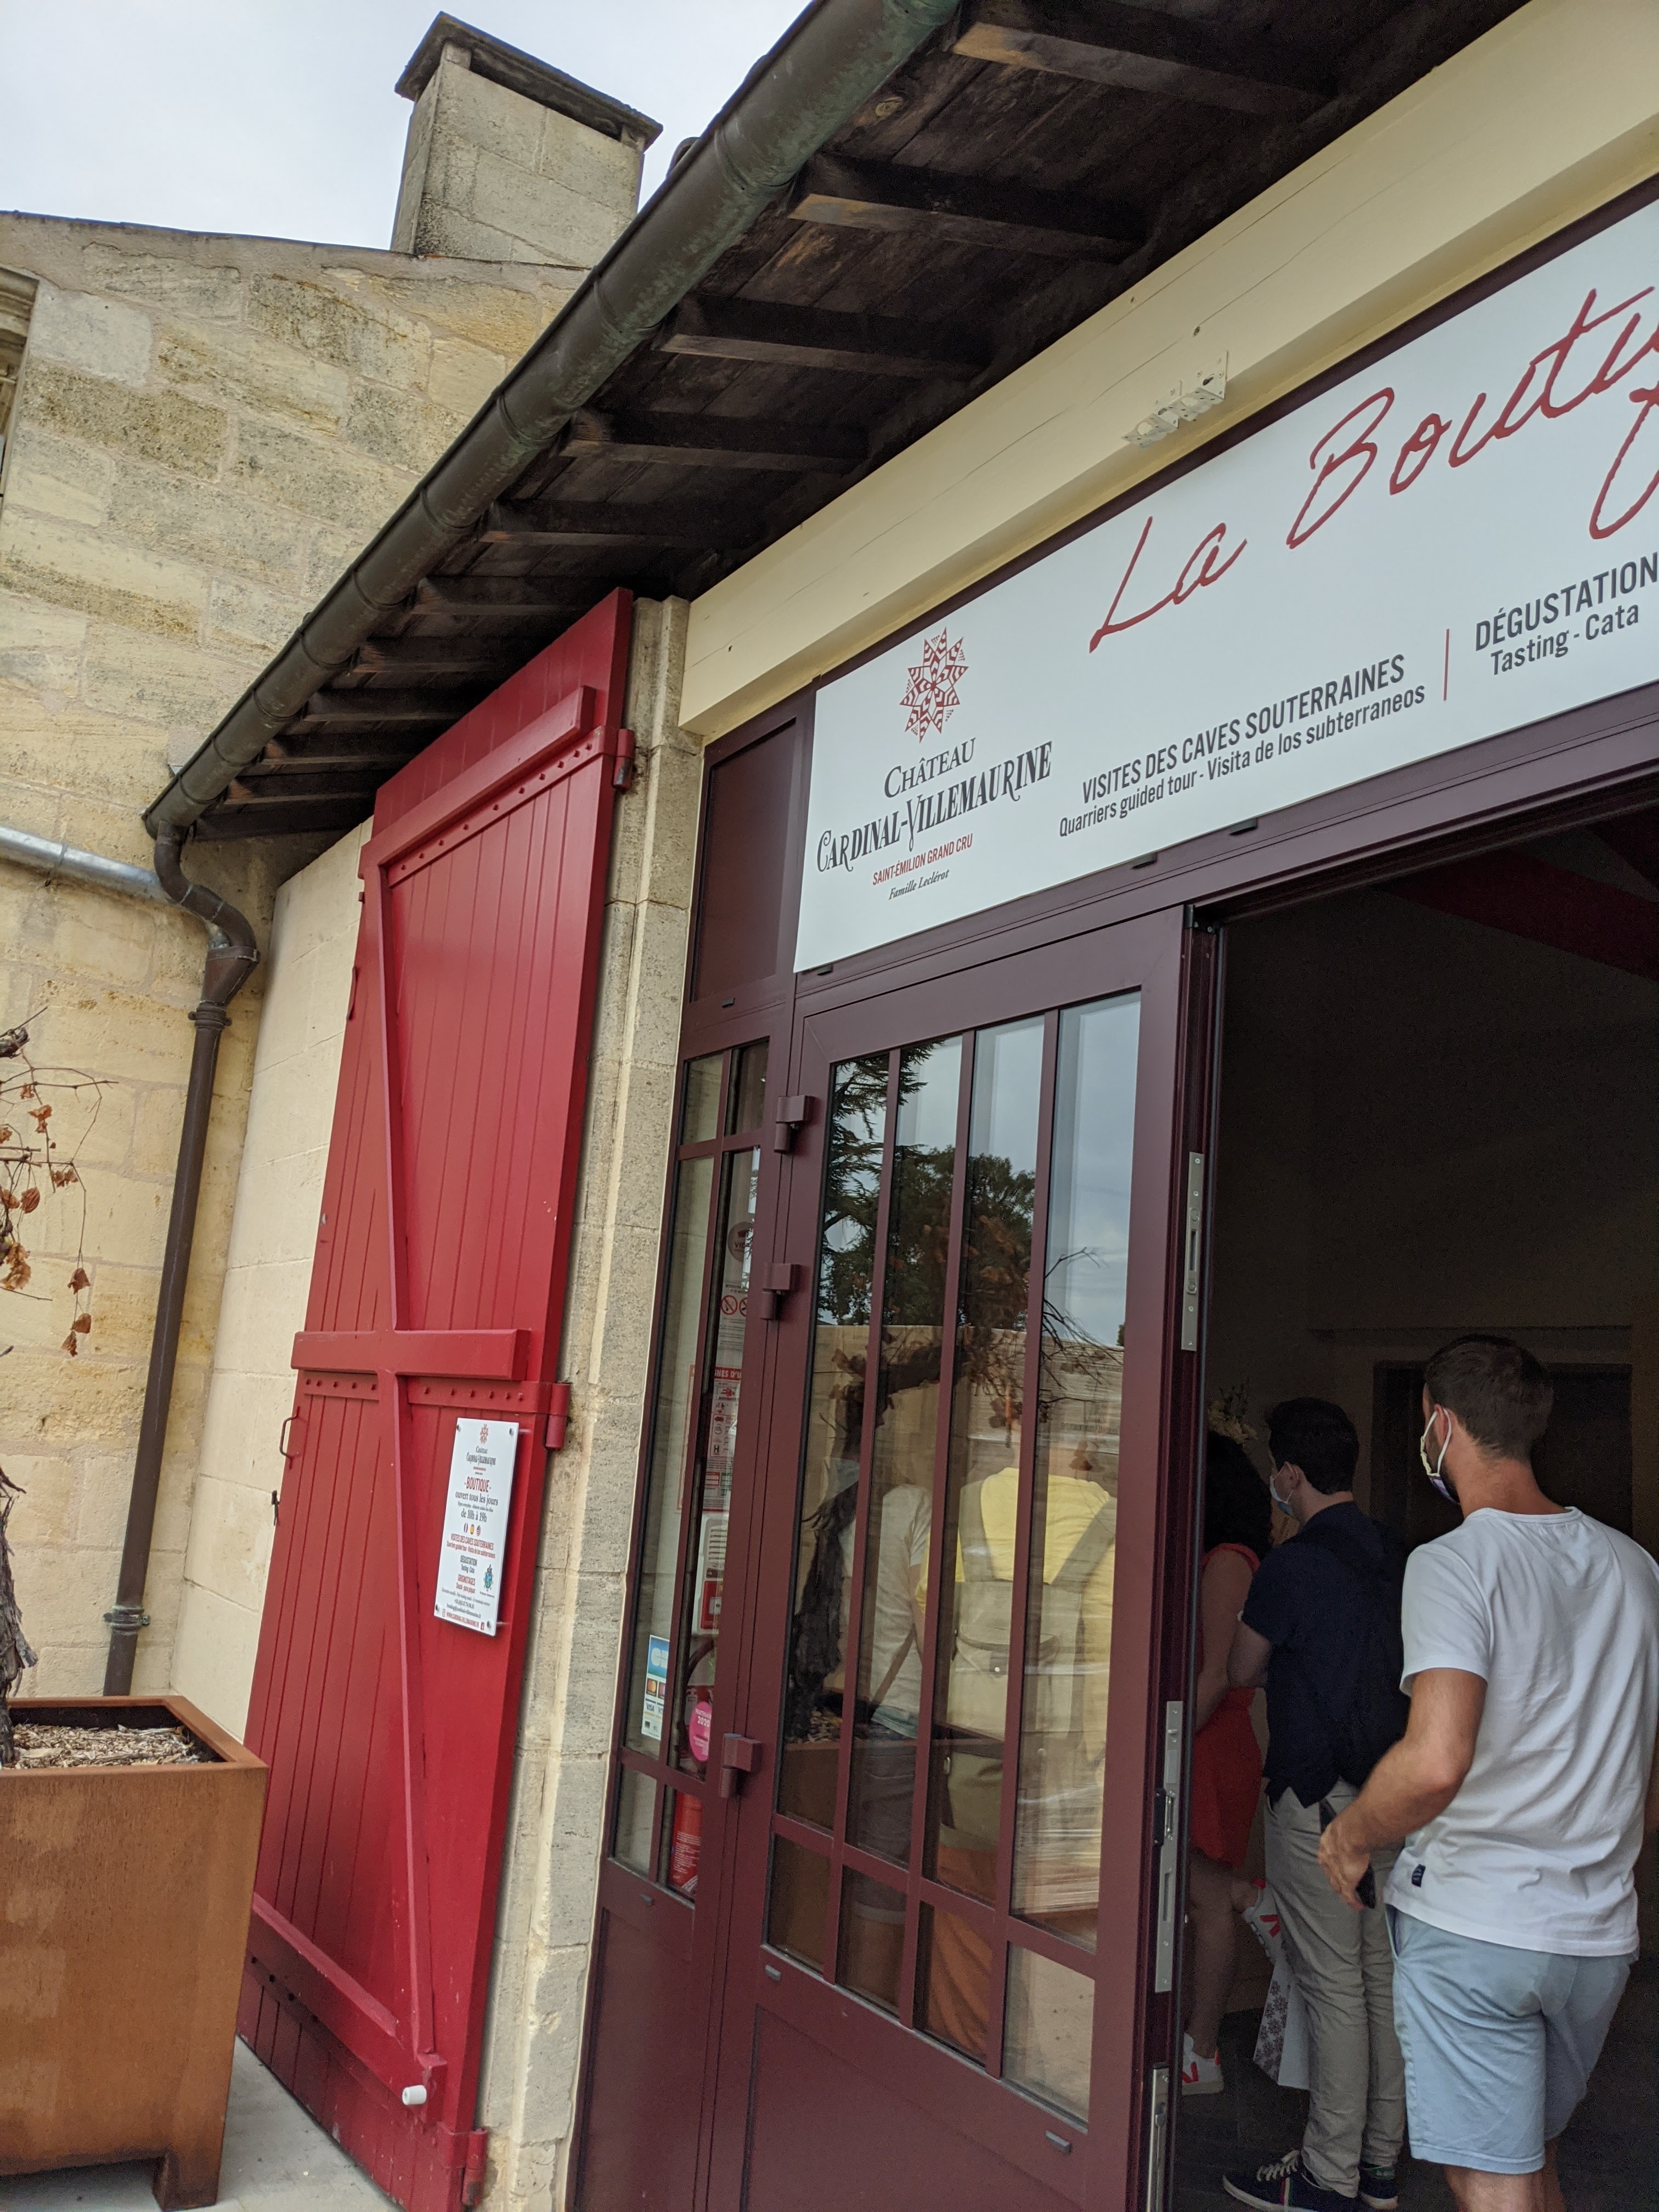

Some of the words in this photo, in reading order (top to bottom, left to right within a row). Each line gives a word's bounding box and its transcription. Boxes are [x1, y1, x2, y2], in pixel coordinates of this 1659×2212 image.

[1089, 516, 1247, 653] La
[1286, 286, 1659, 549] Bouti
[1475, 551, 1658, 651] DÉGUSTATION
[1491, 630, 1569, 675] Tasting
[1585, 604, 1639, 640] Cata
[1082, 759, 1141, 804] VISITES
[1146, 744, 1177, 779] DES
[1182, 719, 1240, 764] CAVES
[1245, 654, 1404, 740] SOUTERRAINES
[884, 737, 977, 798] CHÂTEAU
[1059, 802, 1117, 837] Quarriers
[1119, 778, 1164, 819] guided
[1167, 770, 1197, 795] tour
[1207, 750, 1250, 780] Visita
[1255, 740, 1274, 764] de
[1278, 733, 1301, 755] los
[1306, 685, 1425, 744] subterraneos
[816, 741, 1052, 873] CARDINAL-VILLEMAURINE
[872, 852, 926, 885] SAINT-ÉMILION
[927, 841, 955, 864] GRAND
[956, 833, 973, 852] CRU
[888, 879, 917, 900] Famille
[917, 869, 950, 889] Leclérot
[455, 1491, 469, 1500] ouvert
[486, 1494, 498, 1506] jours
[466, 1476, 489, 1492] BOUTIQUE
[461, 1508, 466, 1517] de
[646, 1702, 654, 1712] VISA
[697, 1716, 710, 1728] 2020
